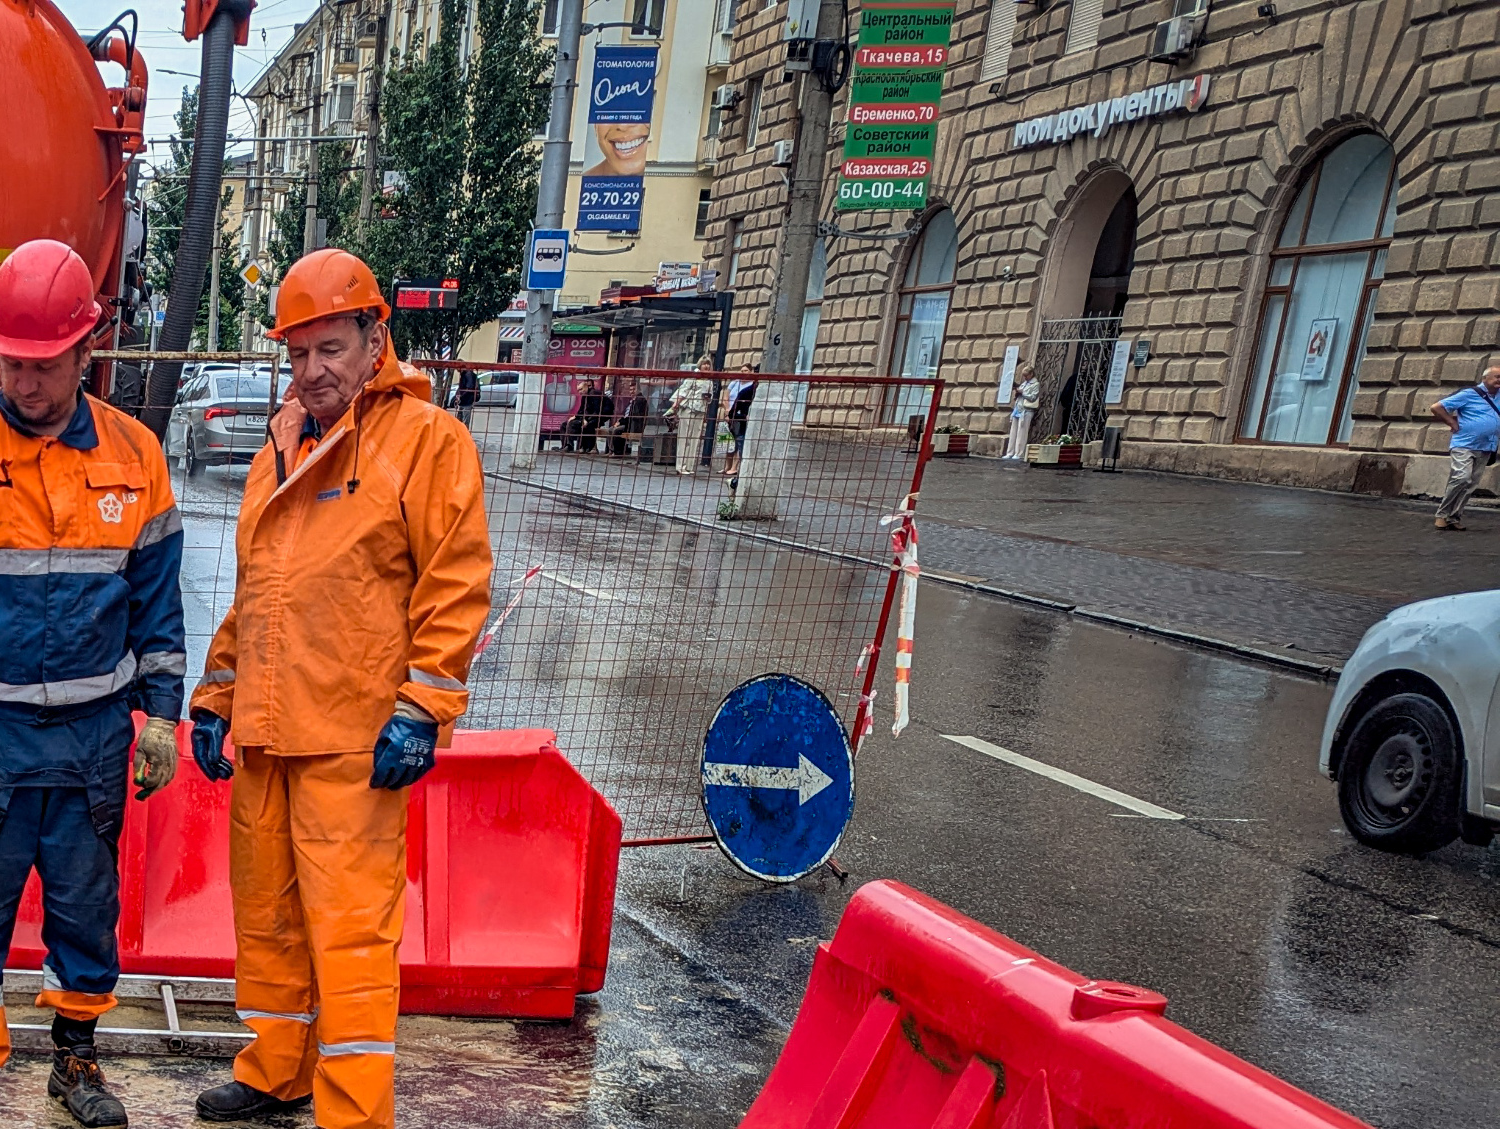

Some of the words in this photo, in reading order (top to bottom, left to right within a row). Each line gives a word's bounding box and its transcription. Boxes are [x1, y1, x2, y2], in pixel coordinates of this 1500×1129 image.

[861, 11, 952, 28] Центральный
[884, 26, 924, 43] район
[596, 60, 655, 68] СТОМАТОЛОГИЯ
[882, 84, 910, 100] район
[853, 106, 934, 123] Еременко,70
[853, 127, 929, 141] Советский
[867, 140, 911, 155] район
[845, 161, 927, 176] Казахская,25
[840, 182, 924, 198] 60-00-44
[570, 339, 605, 348] OZON
